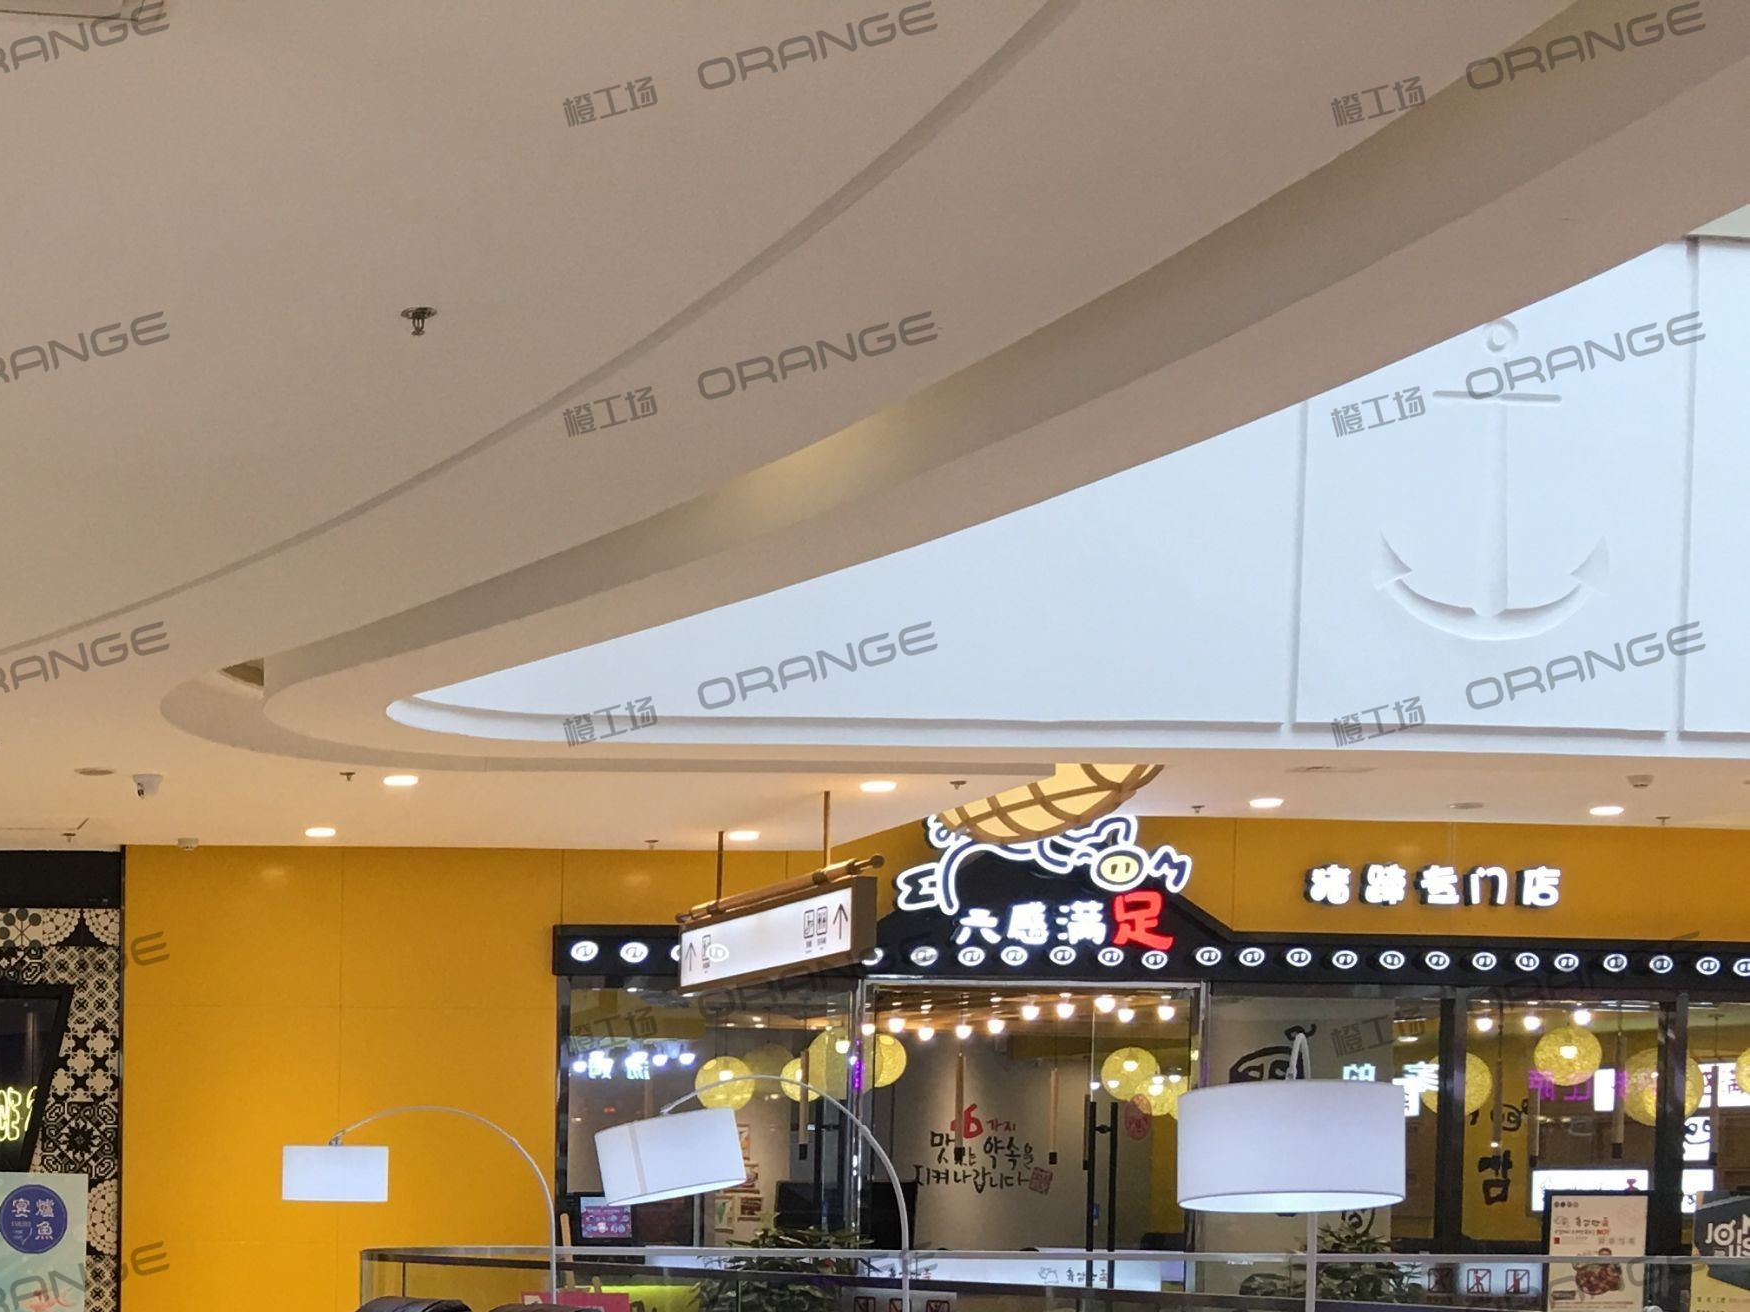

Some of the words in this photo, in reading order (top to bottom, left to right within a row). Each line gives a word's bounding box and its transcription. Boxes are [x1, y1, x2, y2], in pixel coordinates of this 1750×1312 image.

[1306, 864, 1561, 907] 猪蹄专门店
[954, 890, 1174, 950] 六感满足
